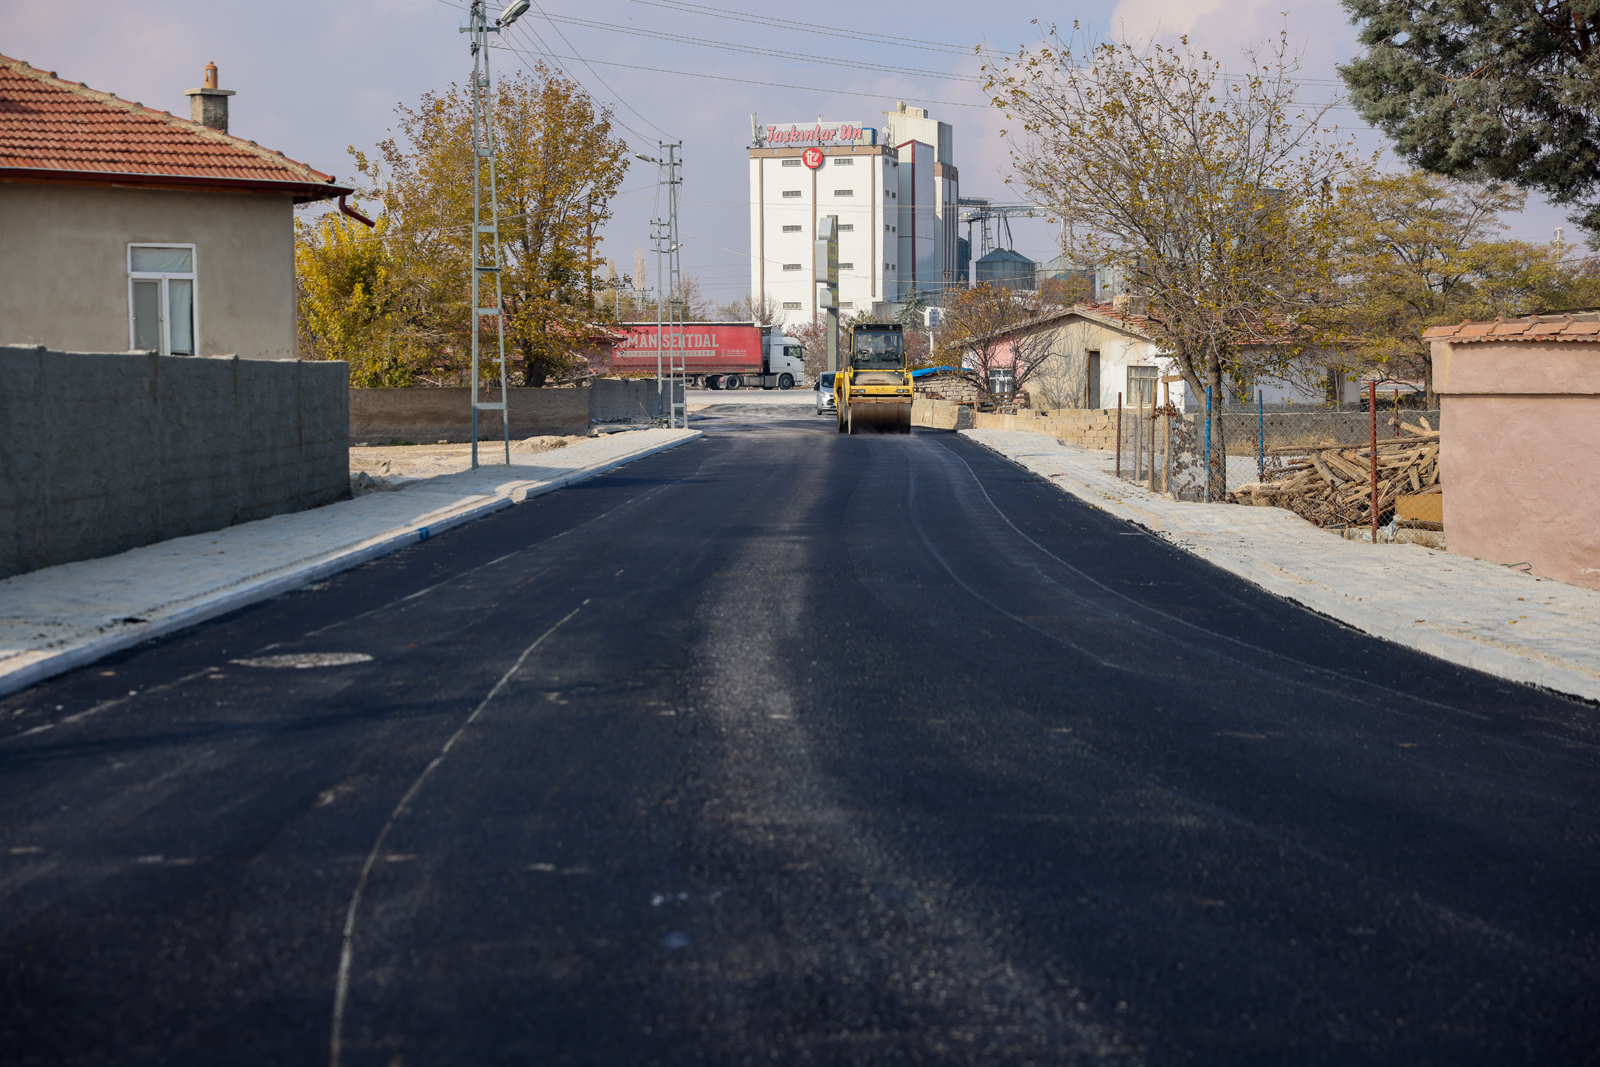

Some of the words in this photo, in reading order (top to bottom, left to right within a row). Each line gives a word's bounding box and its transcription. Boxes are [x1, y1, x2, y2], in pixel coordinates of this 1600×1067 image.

[840, 124, 863, 140] Un
[612, 333, 657, 348] SMAN
[662, 333, 719, 348] SERTDAL
